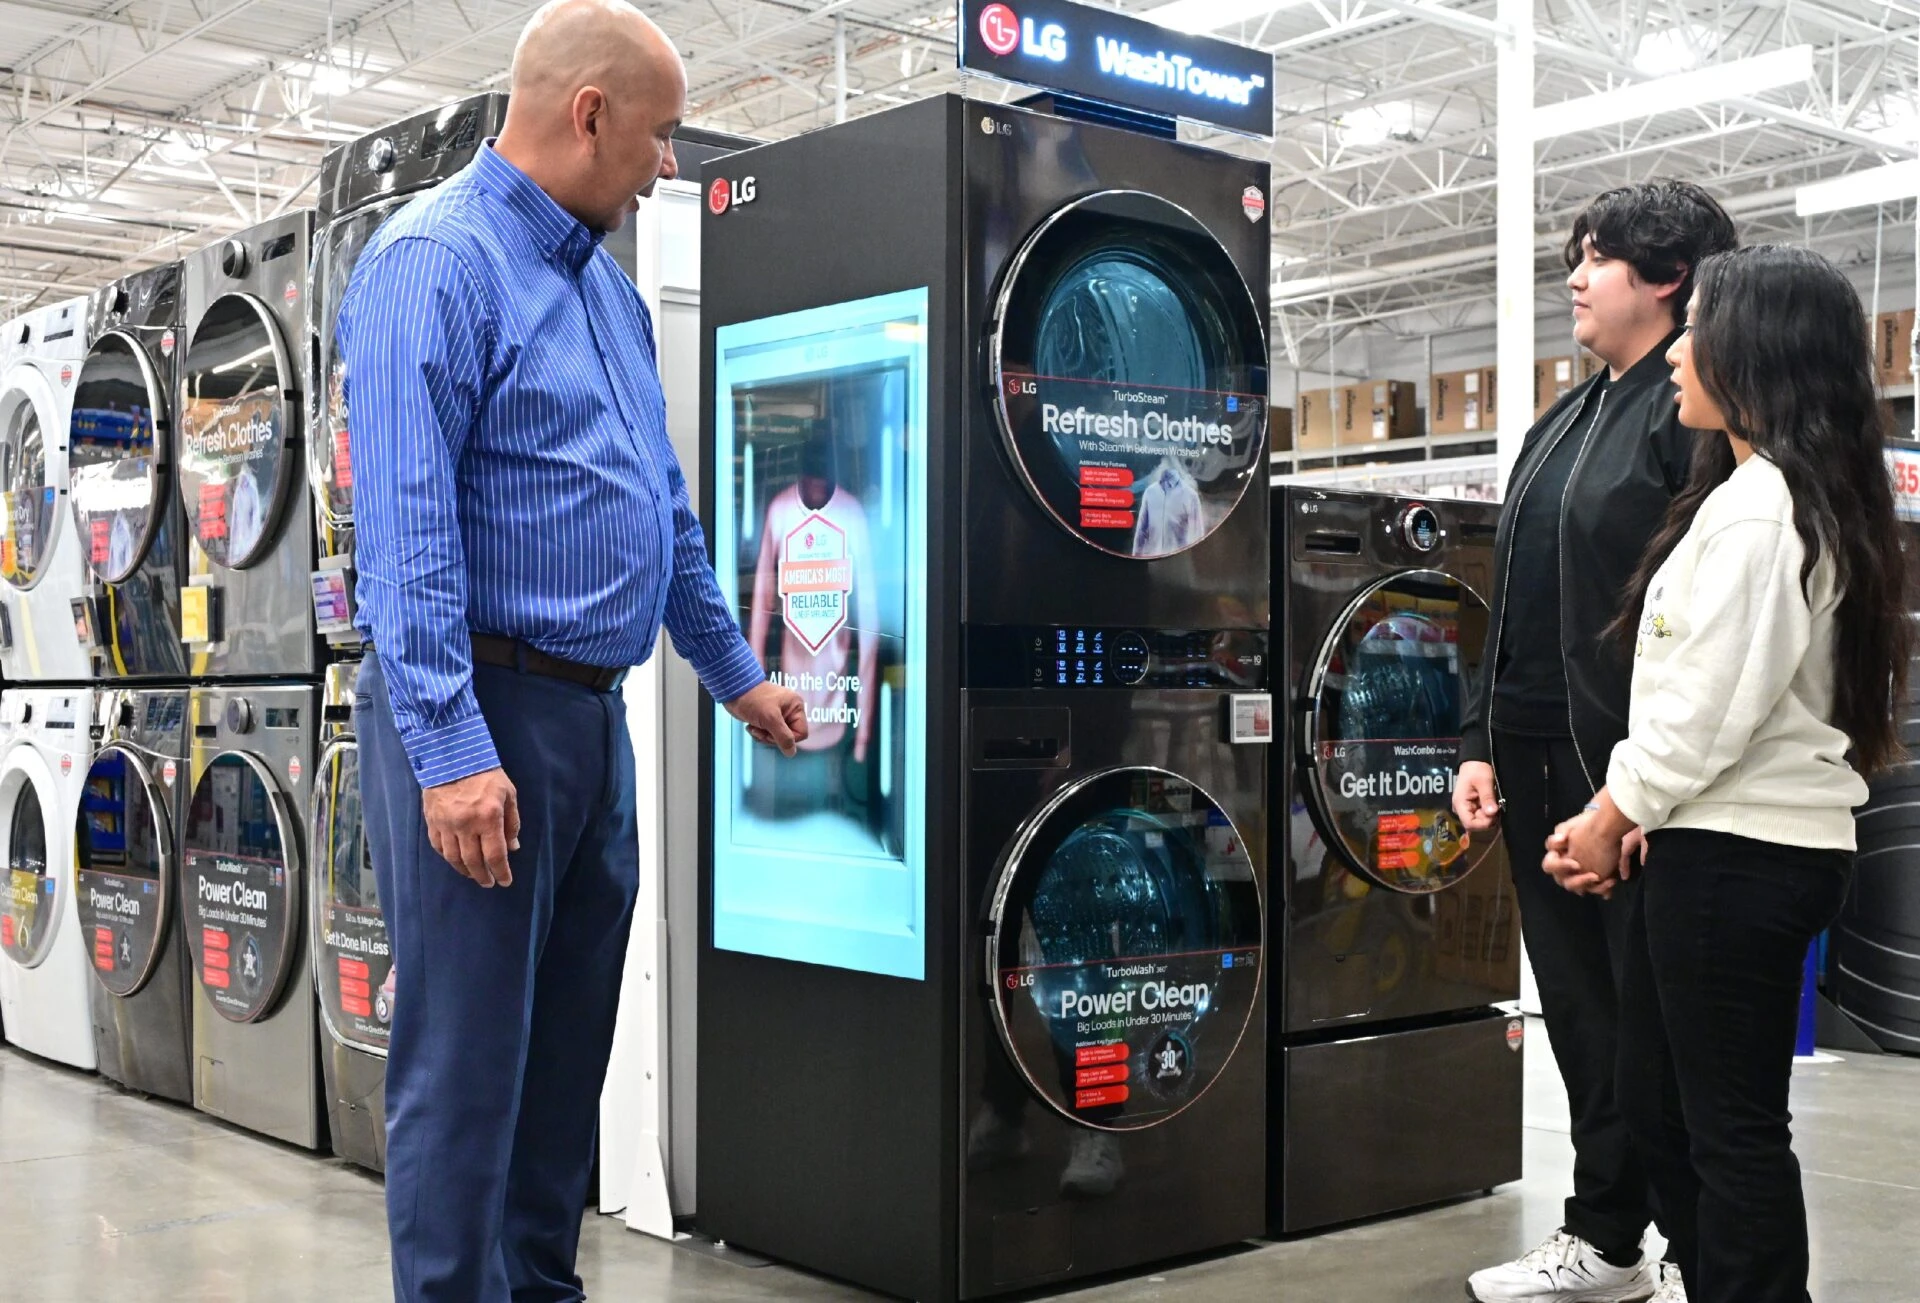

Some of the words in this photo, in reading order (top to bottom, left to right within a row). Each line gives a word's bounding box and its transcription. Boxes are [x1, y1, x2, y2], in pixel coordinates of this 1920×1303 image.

[1022, 17, 1067, 61] LG
[996, 123, 1013, 136] LG
[731, 176, 756, 206] LG
[1023, 382, 1037, 395] LG
[185, 423, 227, 455] Refresh
[228, 418, 273, 448] Clothes
[1042, 404, 1138, 438] Refresh
[1143, 411, 1233, 446] Clothes
[1079, 440, 1098, 451] With
[1099, 441, 1125, 453] Steam
[1135, 443, 1168, 456] Between
[1169, 446, 1200, 458] Washes
[784, 567, 824, 586] AMERICA'S
[791, 594, 839, 609] RELIABLE
[769, 671, 782, 686] AI
[784, 672, 798, 691] to
[800, 672, 823, 691] the
[826, 671, 863, 694] Core,
[804, 702, 861, 728] Laundry
[1334, 748, 1346, 758] LG
[1340, 772, 1376, 798] Get
[1380, 771, 1393, 796] It
[1396, 770, 1444, 795] Done
[90, 887, 114, 911] Power
[115, 892, 140, 916] Clean
[198, 875, 232, 905] Power
[232, 880, 267, 911] Clean
[198, 904, 206, 919] Big
[341, 932, 360, 951] Done
[360, 936, 368, 952] In
[369, 937, 389, 956] Less
[1020, 974, 1034, 987] LG
[1061, 988, 1136, 1019] Power
[1141, 980, 1209, 1008] Clean
[1077, 1021, 1090, 1034] Big
[1091, 1019, 1116, 1031] Loads
[1125, 1014, 1149, 1027] Under
[1150, 1014, 1161, 1024] 30
[1161, 1050, 1177, 1070] 30
